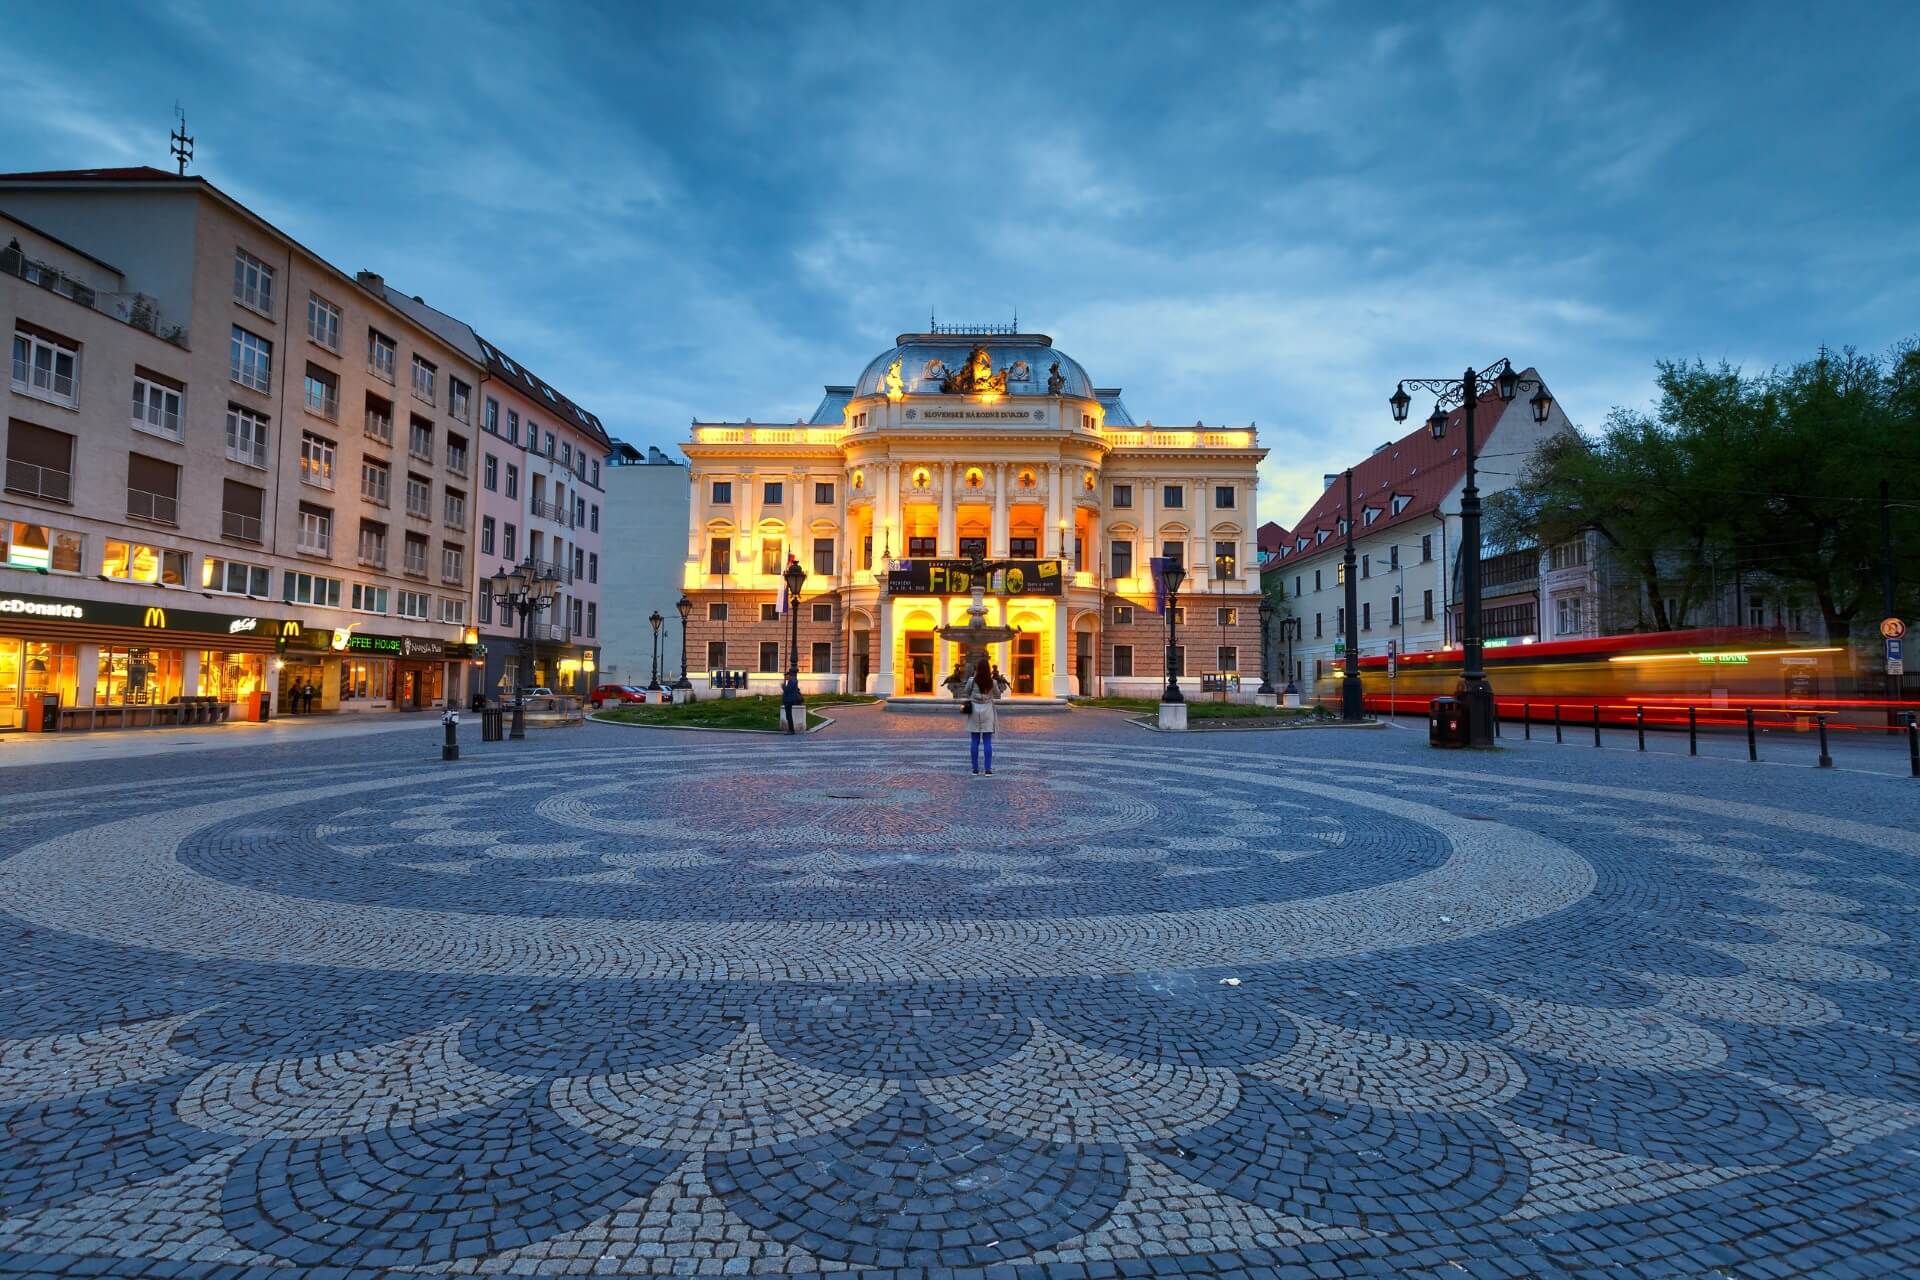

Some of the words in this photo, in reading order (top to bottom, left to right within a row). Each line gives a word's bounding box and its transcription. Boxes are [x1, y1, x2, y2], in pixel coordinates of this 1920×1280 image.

[929, 567, 1024, 593] FIDLIO
[0, 599, 83, 618] cDonald's
[374, 639, 401, 650] HOUSE
